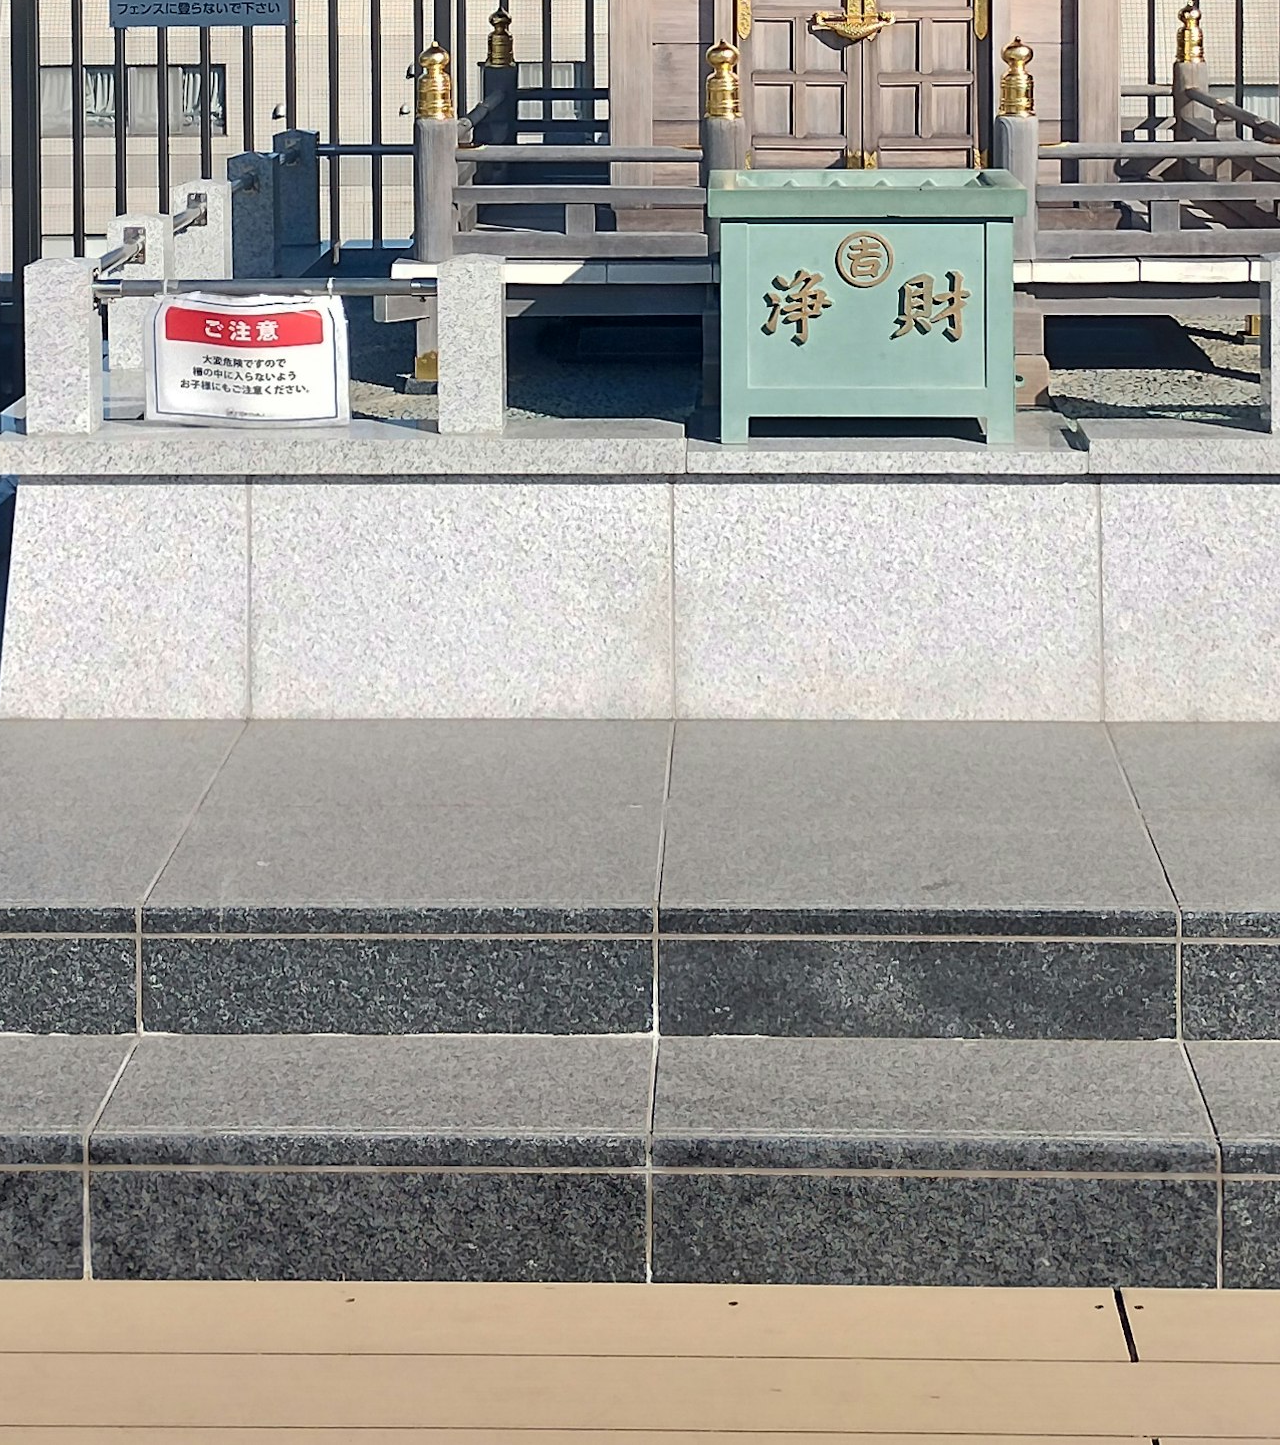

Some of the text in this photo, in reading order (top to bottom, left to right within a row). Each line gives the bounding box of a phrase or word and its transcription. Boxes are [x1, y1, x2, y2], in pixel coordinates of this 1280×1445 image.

[116, 2, 281, 16] フェンスに登らないで下さい
[889, 270, 971, 344] 財
[204, 319, 280, 342] ご注意
[201, 354, 287, 369] 大変危険ですので
[180, 379, 311, 395] お子様にもご注意ください。
